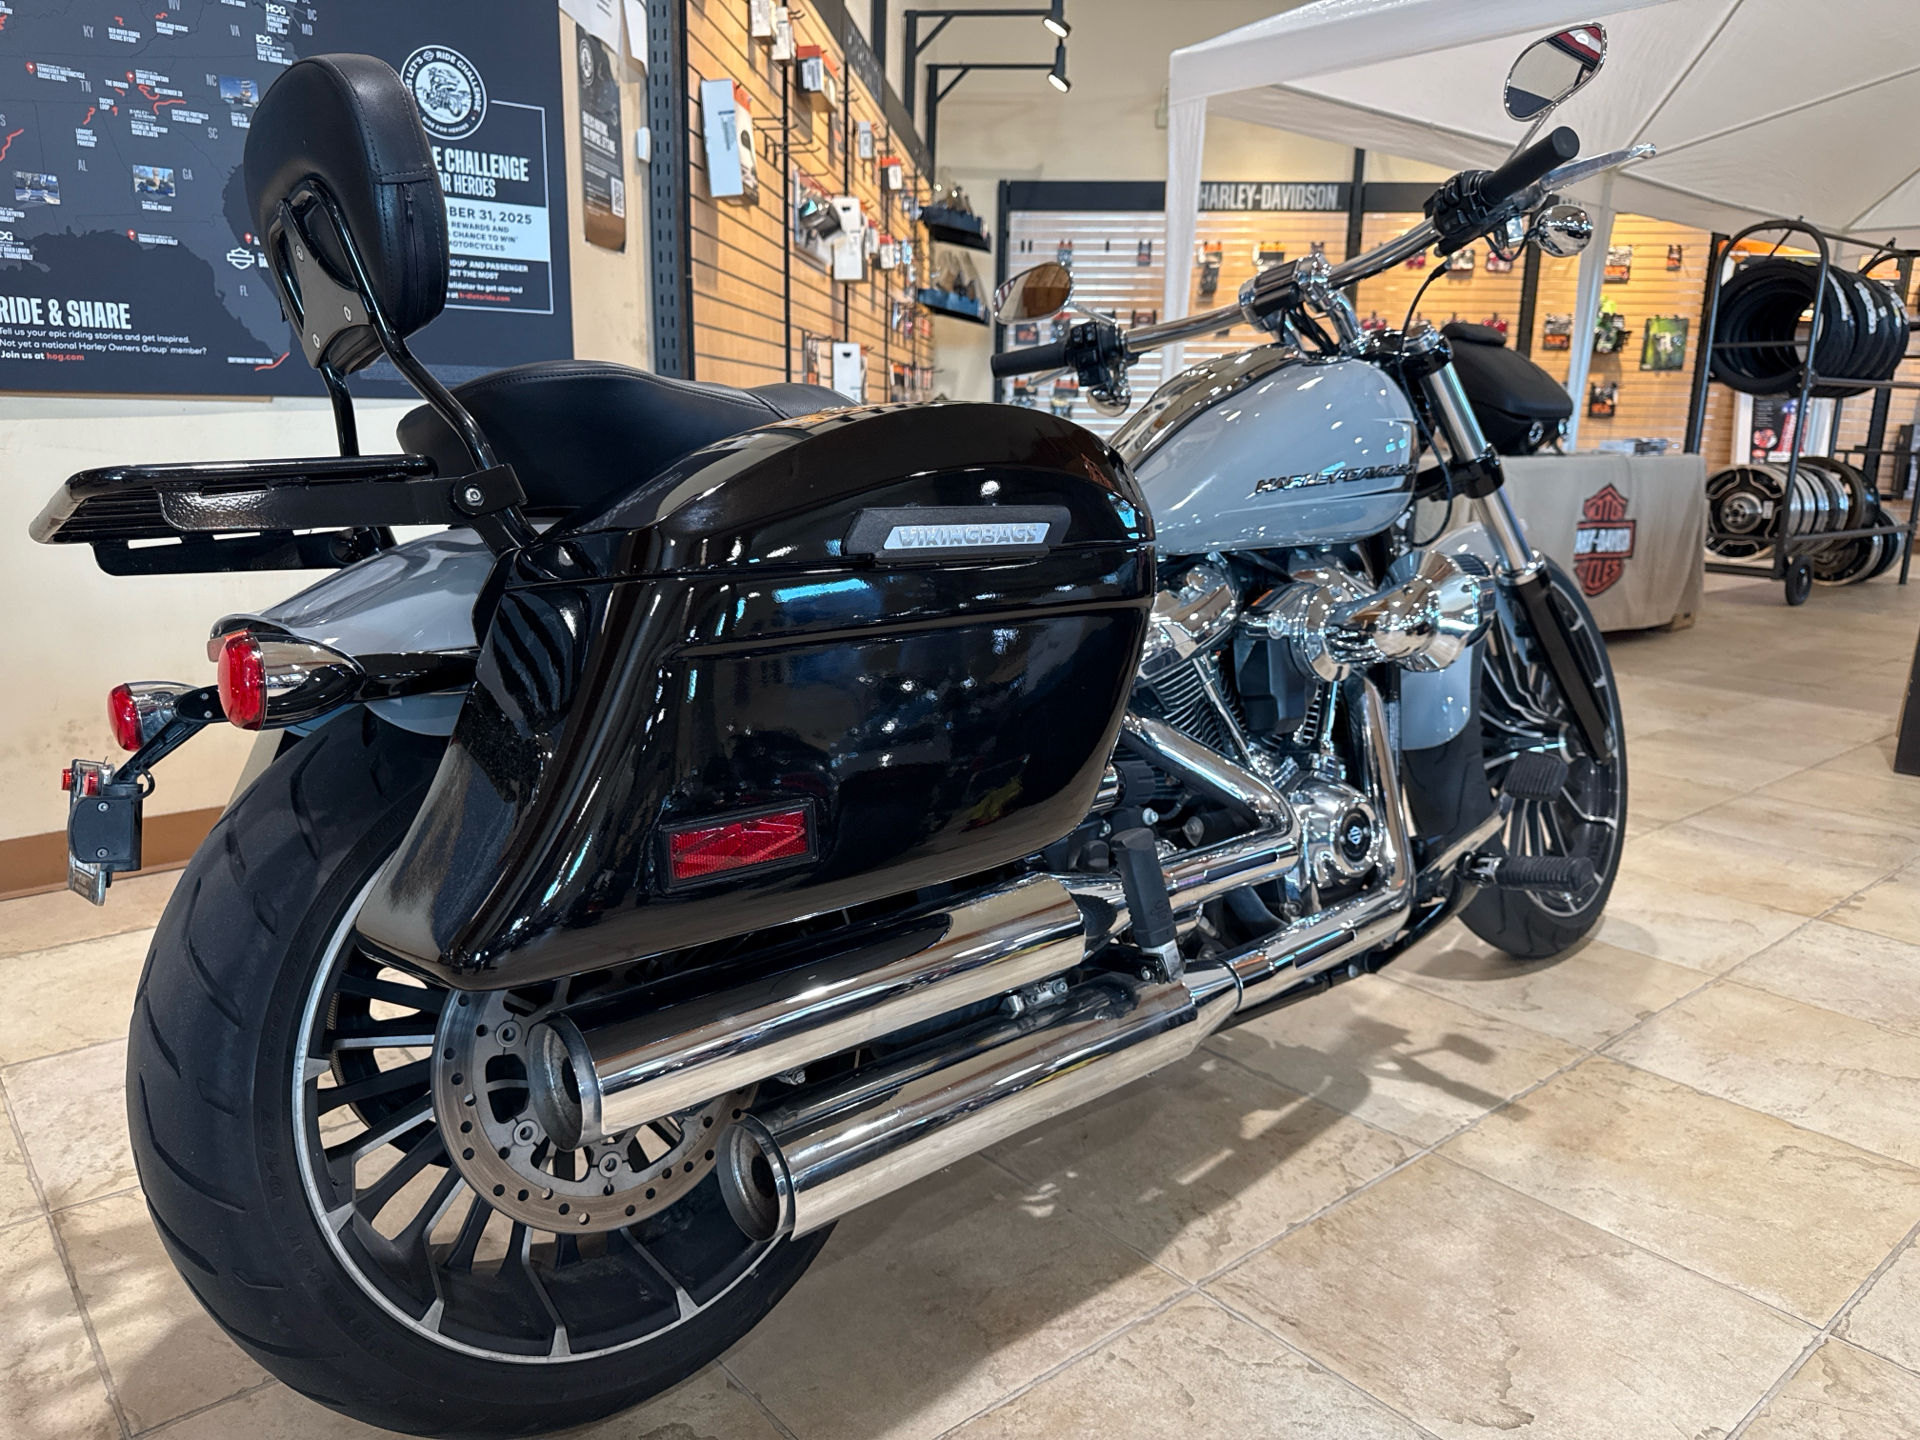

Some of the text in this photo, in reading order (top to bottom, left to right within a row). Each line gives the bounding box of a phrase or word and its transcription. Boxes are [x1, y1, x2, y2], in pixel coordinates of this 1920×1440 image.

[307, 8, 318, 22] DC
[82, 25, 94, 38] KY
[230, 24, 240, 37] VA
[37, 66, 60, 75] TENNESSEE
[60, 69, 86, 80] MOTORCYCLE
[80, 80, 92, 92] TN
[112, 80, 129, 89] DRAGON
[206, 74, 217, 86] NC
[406, 50, 482, 112] LET'S RIDE CHALLENGE
[0, 114, 6, 126] S
[422, 116, 470, 133] RIDE FOR HEROES
[208, 126, 218, 140] SC
[78, 160, 88, 172] AL
[445, 148, 529, 182] CHALLENGE
[182, 168, 193, 181] GA
[438, 172, 496, 198] OR HEROES
[1200, 184, 1339, 210] HARLEY-DAVIDSON
[479, 210, 496, 222] 31,
[499, 211, 532, 225] 2025
[451, 222, 490, 232] REWARDS
[0, 230, 13, 240] OG
[452, 231, 486, 240] CHANCE
[469, 261, 485, 269] AND
[486, 262, 529, 273] PASSENGER
[462, 270, 477, 278] THE
[478, 272, 499, 280] MOST
[240, 284, 248, 297] FL
[448, 282, 476, 290] alidator
[498, 285, 523, 294] started
[0, 296, 132, 330] RIDE & SHARE
[0, 326, 12, 336] Tell
[26, 330, 47, 338] your
[48, 330, 67, 339] epic
[68, 330, 93, 340] riding
[94, 332, 123, 340] stories
[124, 333, 140, 342] and
[142, 334, 156, 344] get
[157, 334, 190, 344] inspired.
[0, 338, 16, 348] Not
[18, 340, 32, 350] yet
[42, 341, 77, 350] national
[79, 342, 107, 352] Harley
[108, 342, 140, 352] Owners
[170, 346, 207, 356] member?
[0, 350, 84, 362] Join us at hog.com
[1255, 464, 1416, 492] HARLEY-DAVIDSO
[899, 524, 1038, 547] VIKINGBAGS
